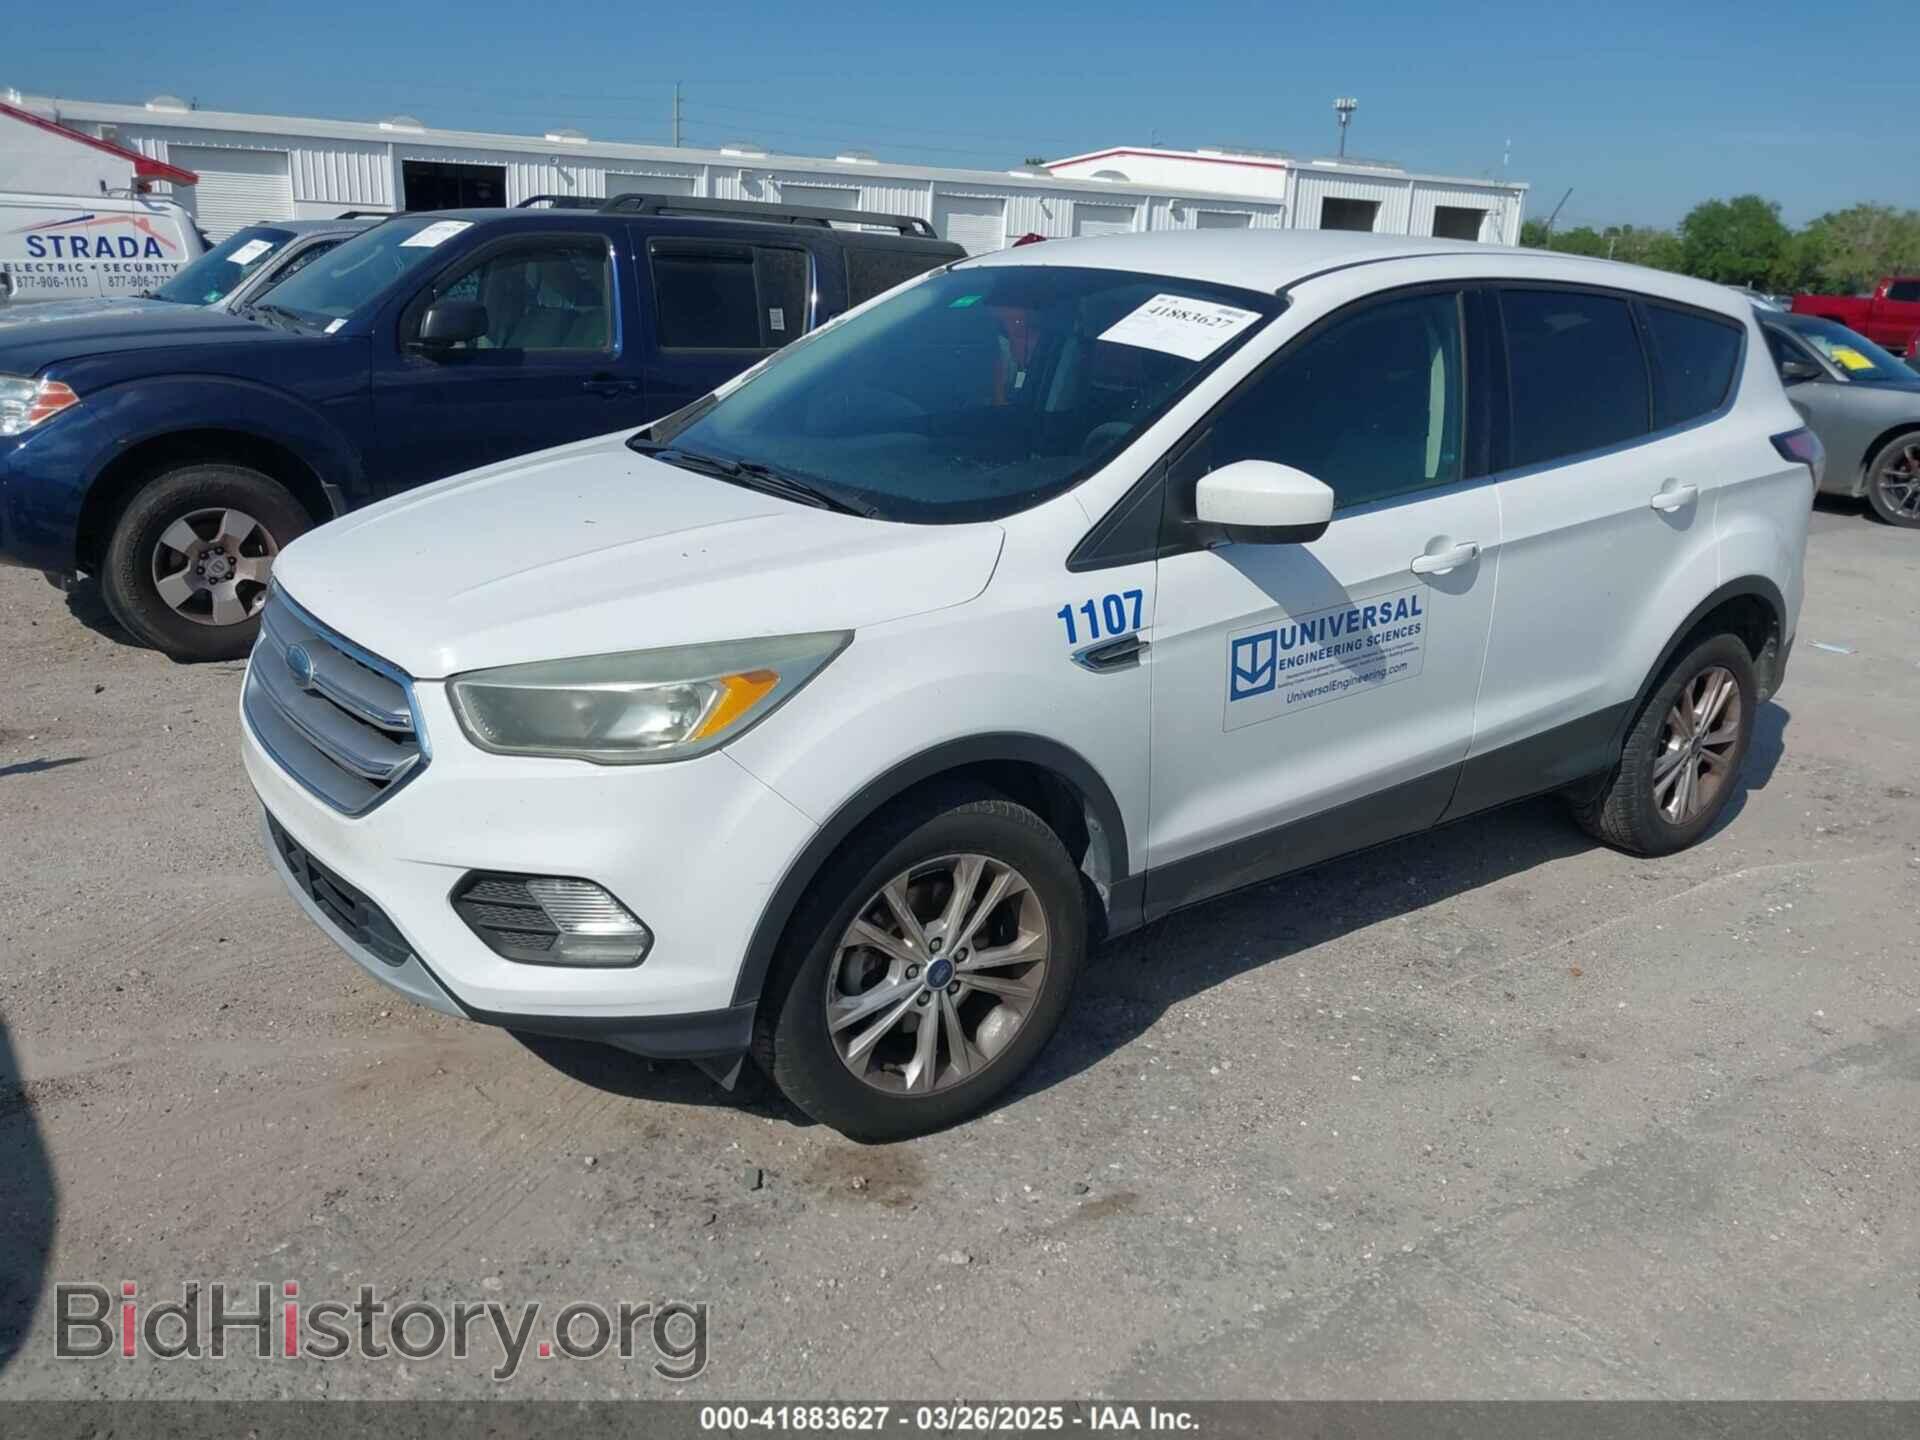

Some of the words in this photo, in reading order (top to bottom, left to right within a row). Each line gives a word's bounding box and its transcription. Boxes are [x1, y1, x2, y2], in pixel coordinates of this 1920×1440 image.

[26, 235, 164, 259] STRADA
[3, 263, 84, 273] ELECTRIC
[103, 263, 178, 273] SECURITY
[16, 275, 88, 289] 877-906-1113
[1148, 305, 1234, 328] 41883627
[1057, 588, 1143, 644] 1107
[1279, 594, 1423, 651] UNIVERSAL
[1278, 638, 1363, 671] ENGINEERING
[1365, 622, 1422, 648] SCIENCES
[1286, 662, 1408, 704] UniversalEngineering.com
